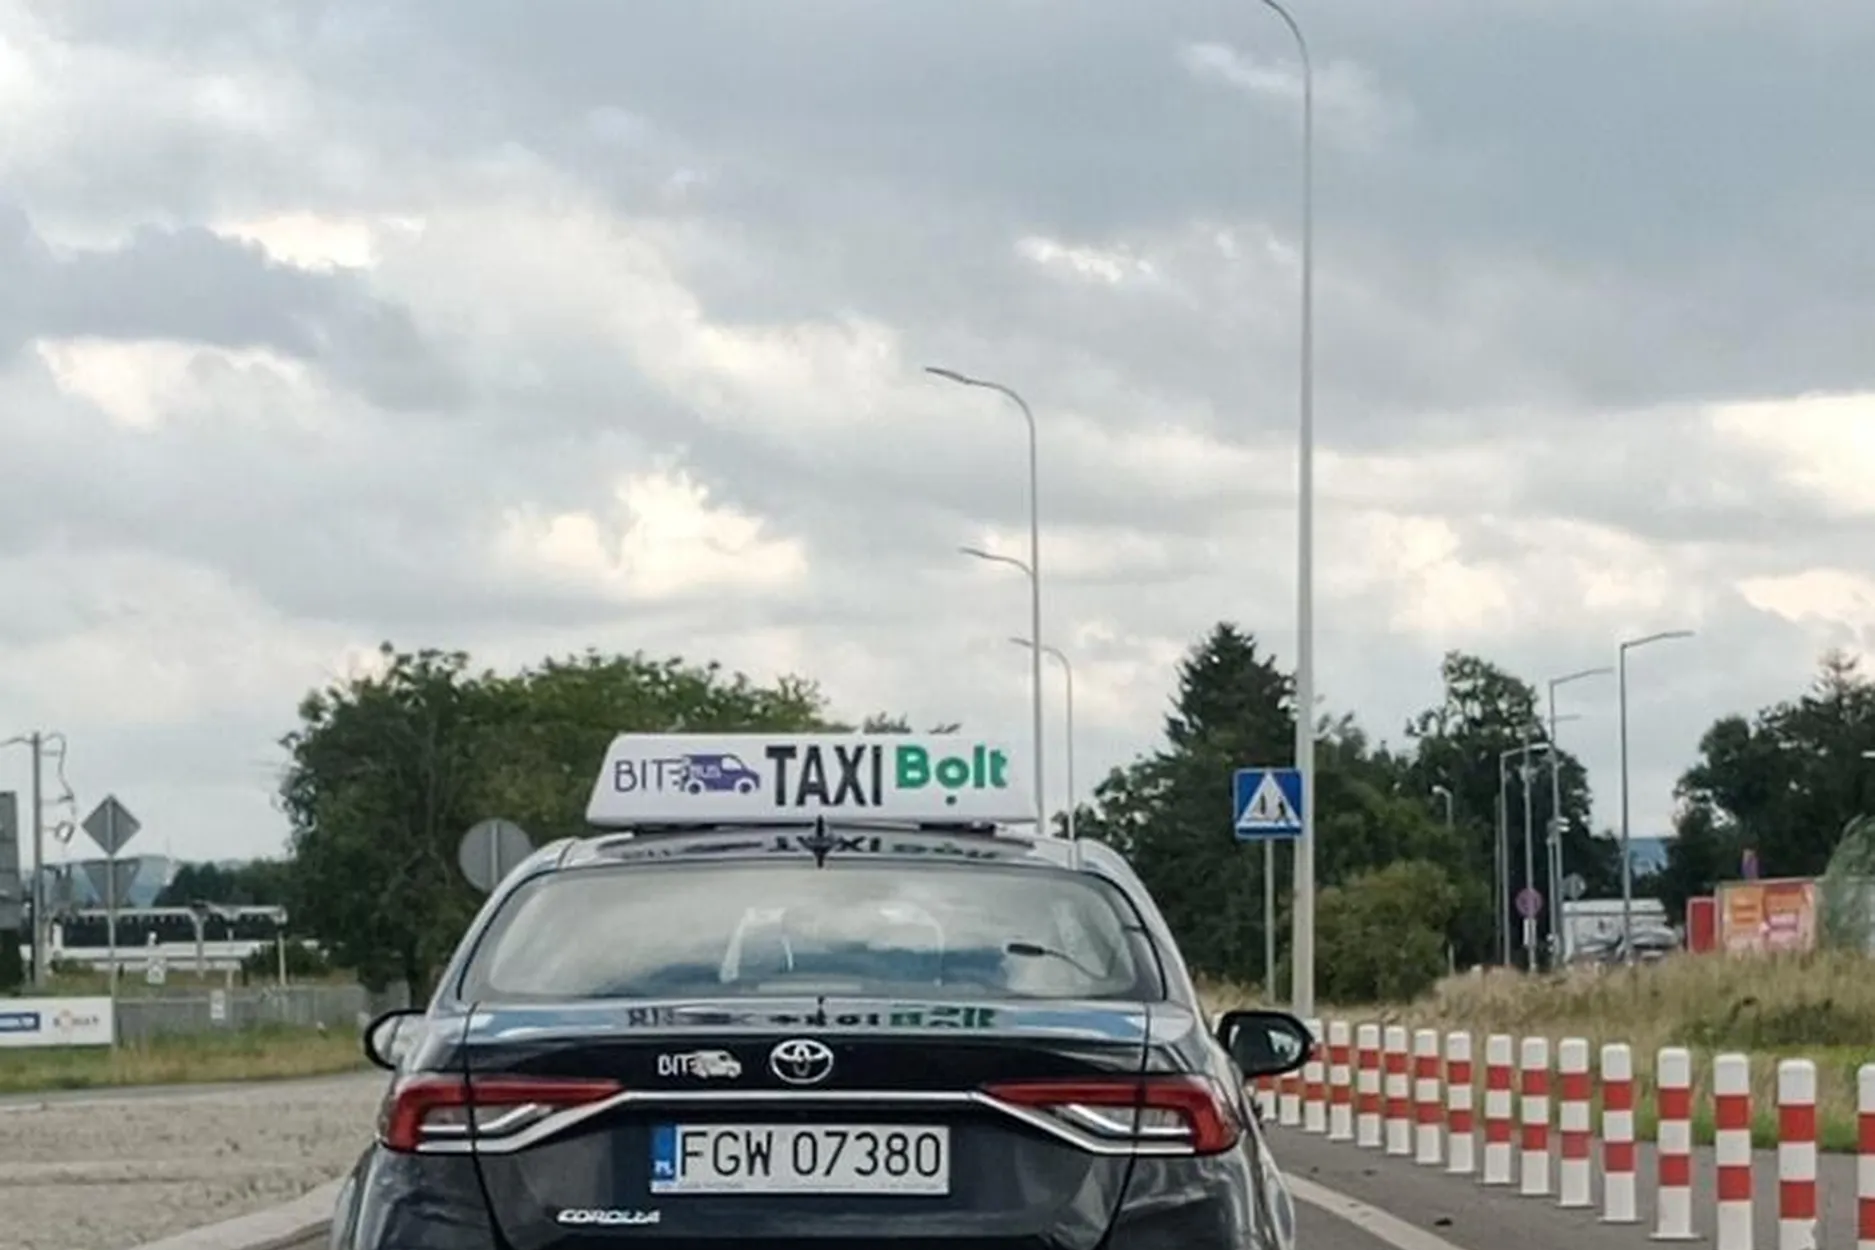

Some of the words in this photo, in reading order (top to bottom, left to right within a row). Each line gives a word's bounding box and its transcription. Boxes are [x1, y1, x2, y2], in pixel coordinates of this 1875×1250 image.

[614, 758, 675, 793] BIT
[765, 744, 884, 808] TAXI
[895, 741, 1009, 804] Bolt
[680, 1130, 773, 1178] FGW
[792, 1130, 942, 1178] 07380
[556, 1208, 662, 1225] COROLLA
